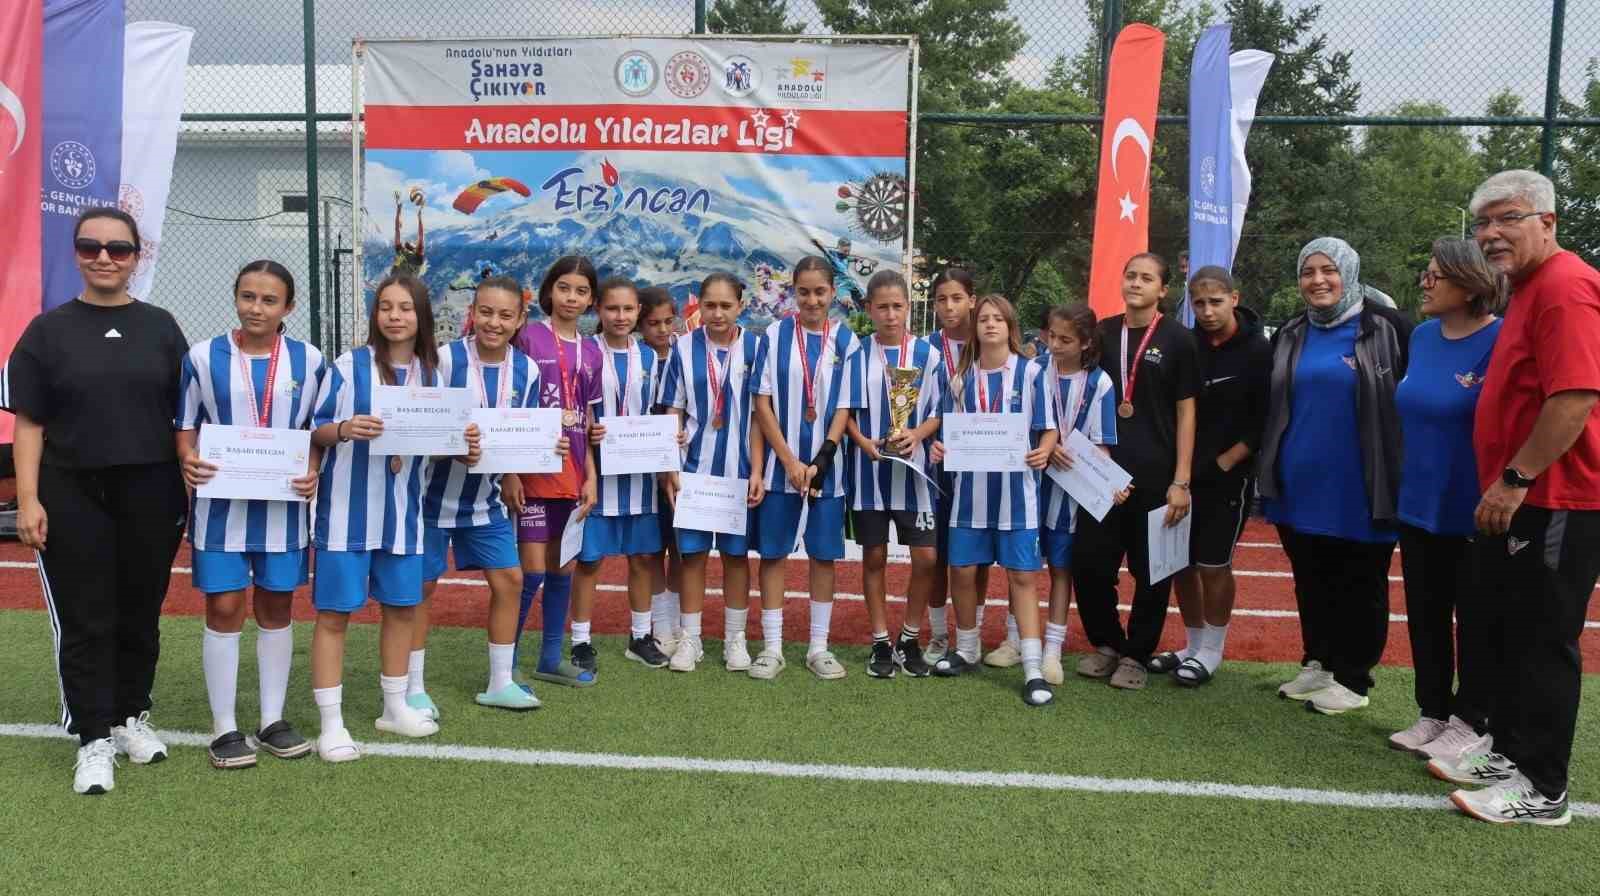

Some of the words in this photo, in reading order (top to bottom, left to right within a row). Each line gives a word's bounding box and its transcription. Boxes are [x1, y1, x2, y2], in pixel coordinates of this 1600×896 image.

[446, 47, 518, 58] Anadolu'nun
[522, 46, 573, 57] Yıldızları
[464, 118, 586, 145] Anadolu
[595, 118, 728, 146] Yıldızlar
[542, 158, 711, 215] Erzincan
[50, 191, 99, 207] GENÇLİK
[915, 511, 936, 531] 45
